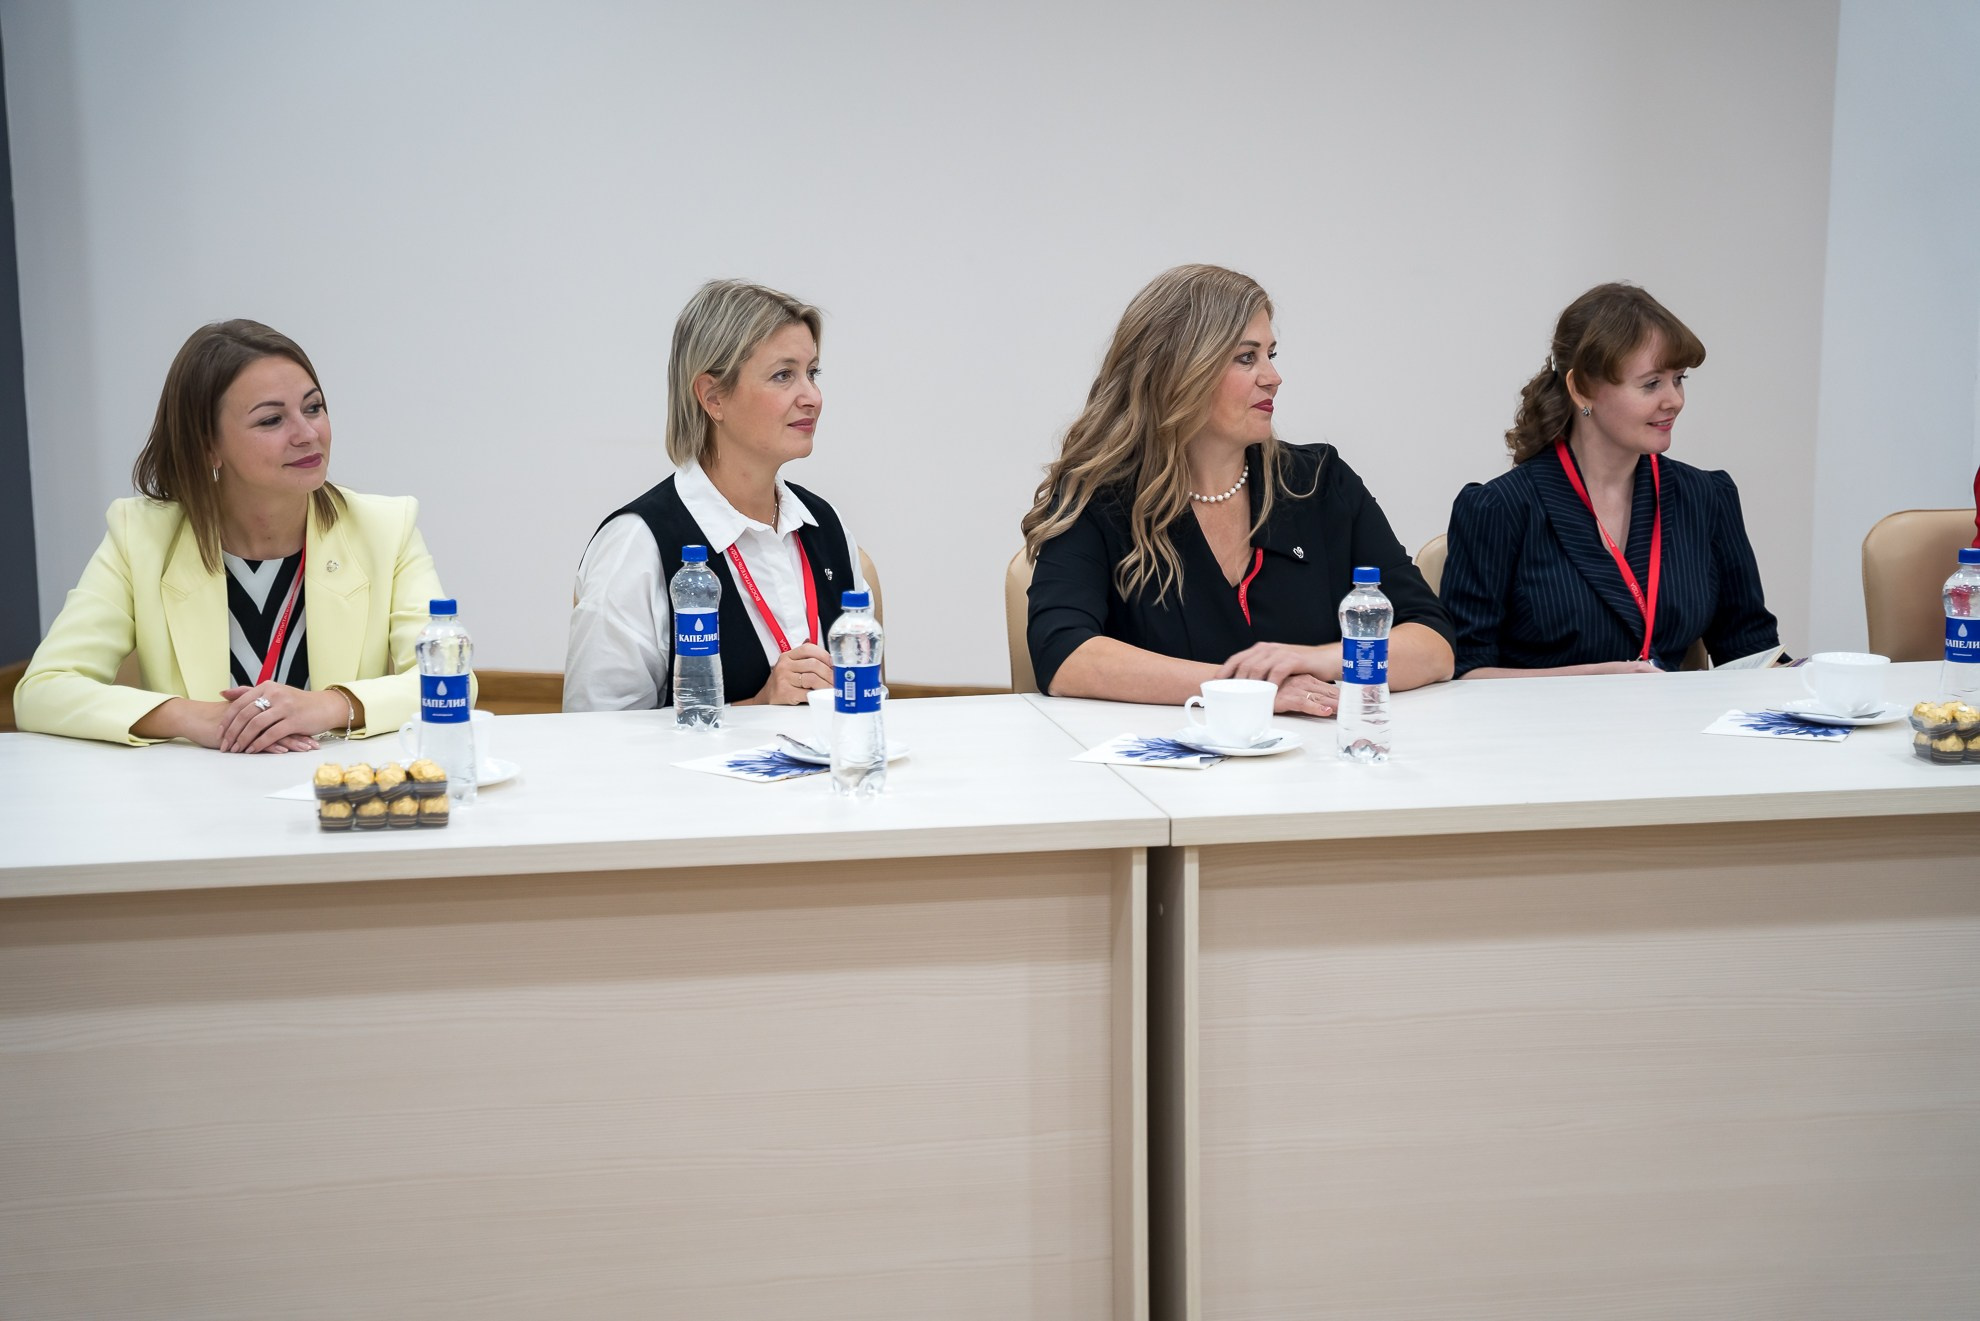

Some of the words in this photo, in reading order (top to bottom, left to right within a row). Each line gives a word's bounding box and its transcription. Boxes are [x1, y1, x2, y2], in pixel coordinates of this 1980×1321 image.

[730, 546, 741, 562] ГОДА
[739, 561, 761, 602] ВОСПИТАТЕЛЬ
[678, 632, 718, 643] КАПЕЛИЯ
[1945, 638, 1980, 649] КАПЕЛИ
